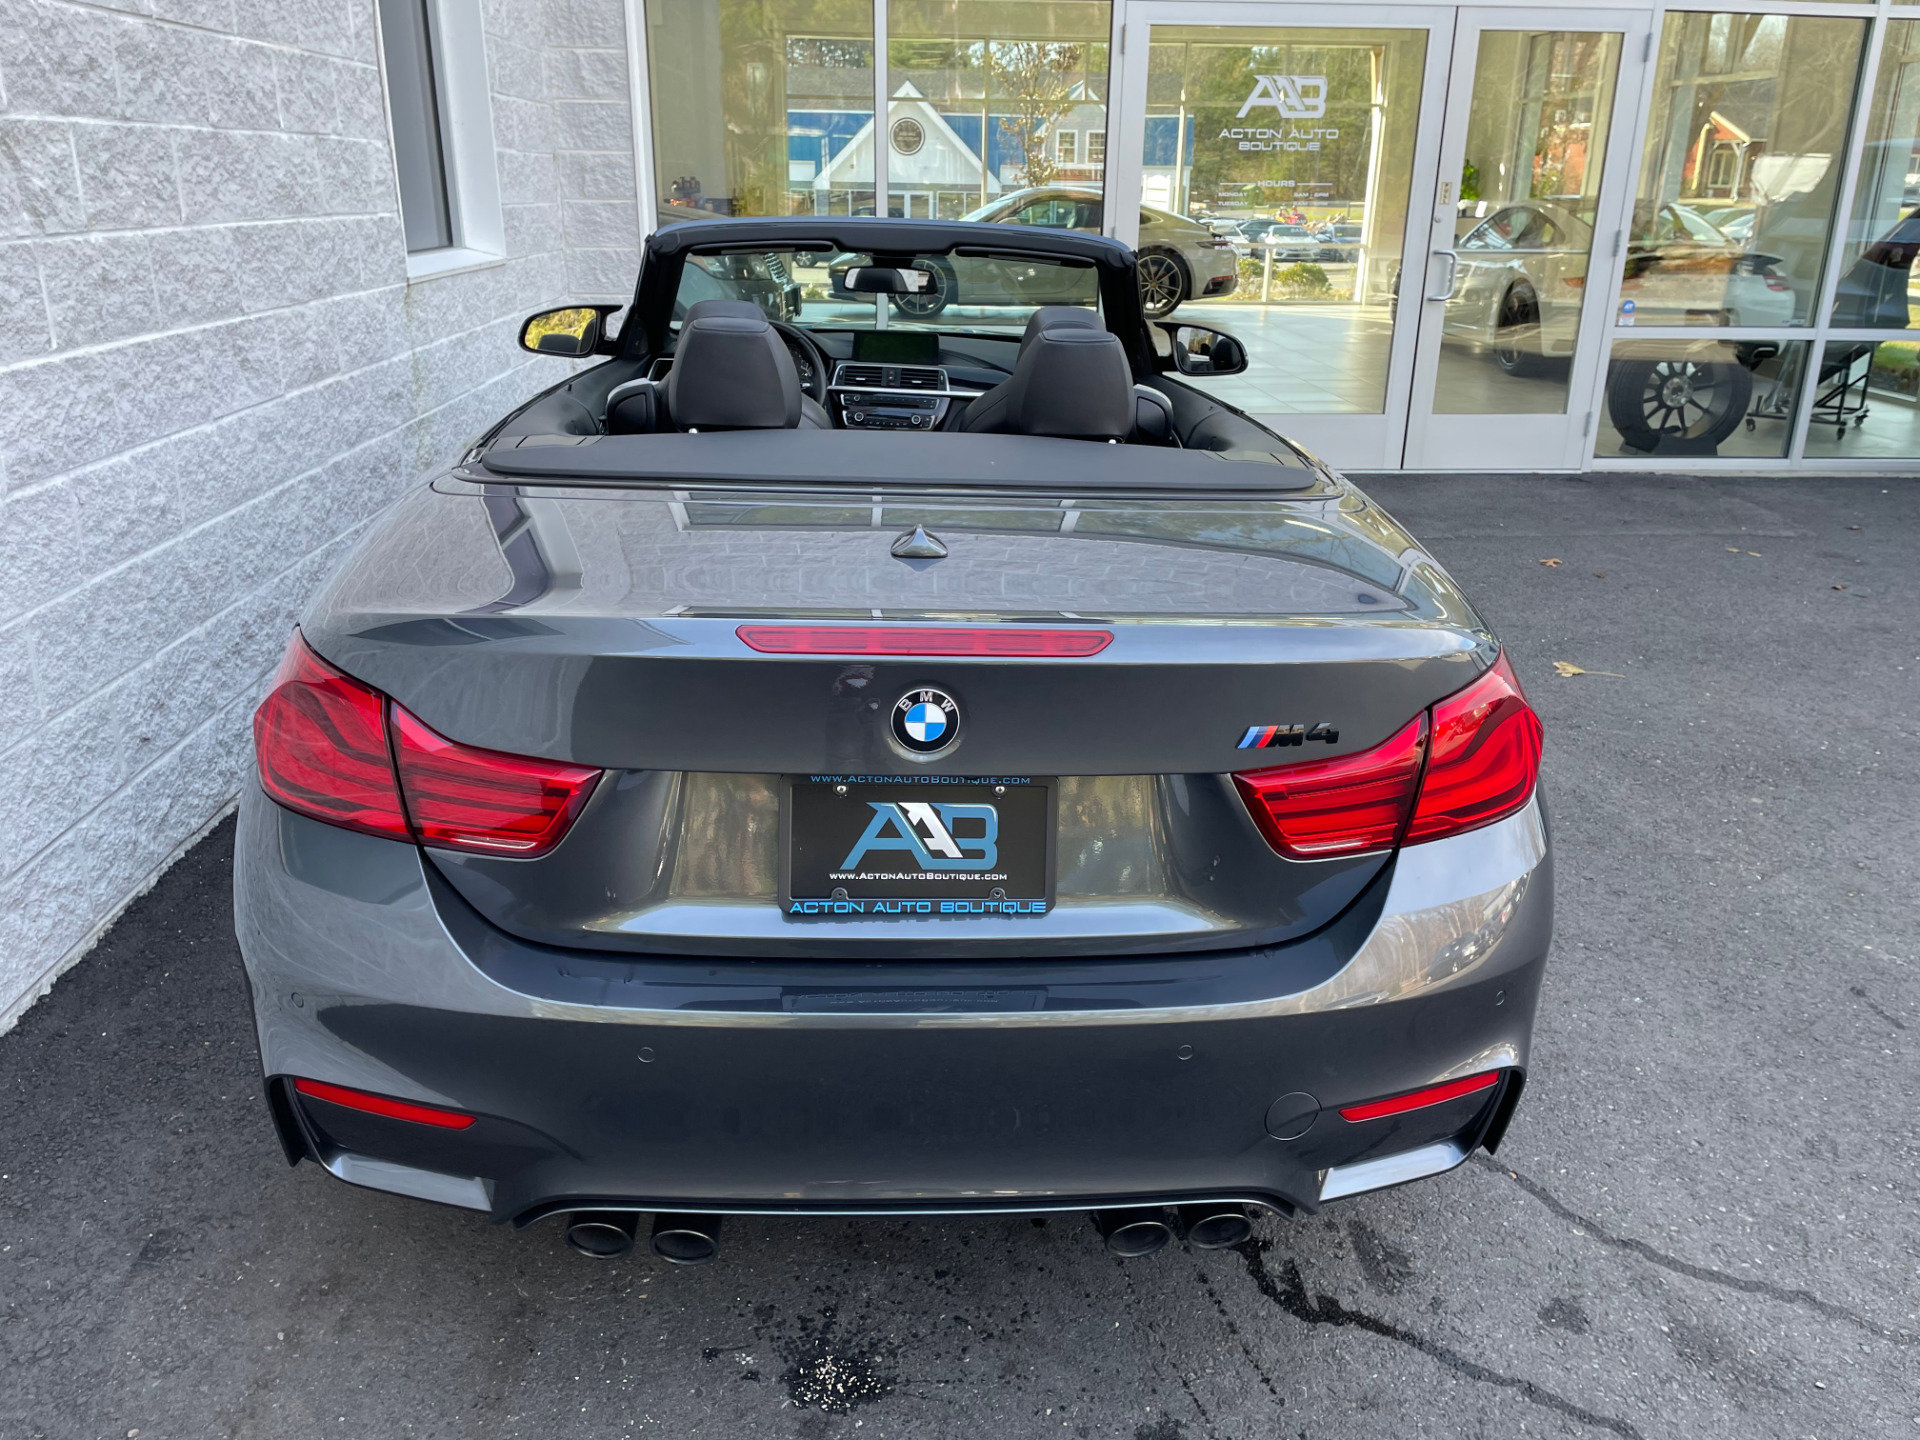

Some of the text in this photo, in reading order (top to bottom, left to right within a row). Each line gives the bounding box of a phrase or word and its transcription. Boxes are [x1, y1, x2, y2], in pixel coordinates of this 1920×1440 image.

[1219, 128, 1339, 139] ACTON AUTO
[1238, 141, 1320, 151] BOUTIQUE
[898, 691, 955, 713] BMW
[1261, 722, 1340, 749] M4
[789, 901, 1047, 915] ACTON AUTO BOUTIQUE
